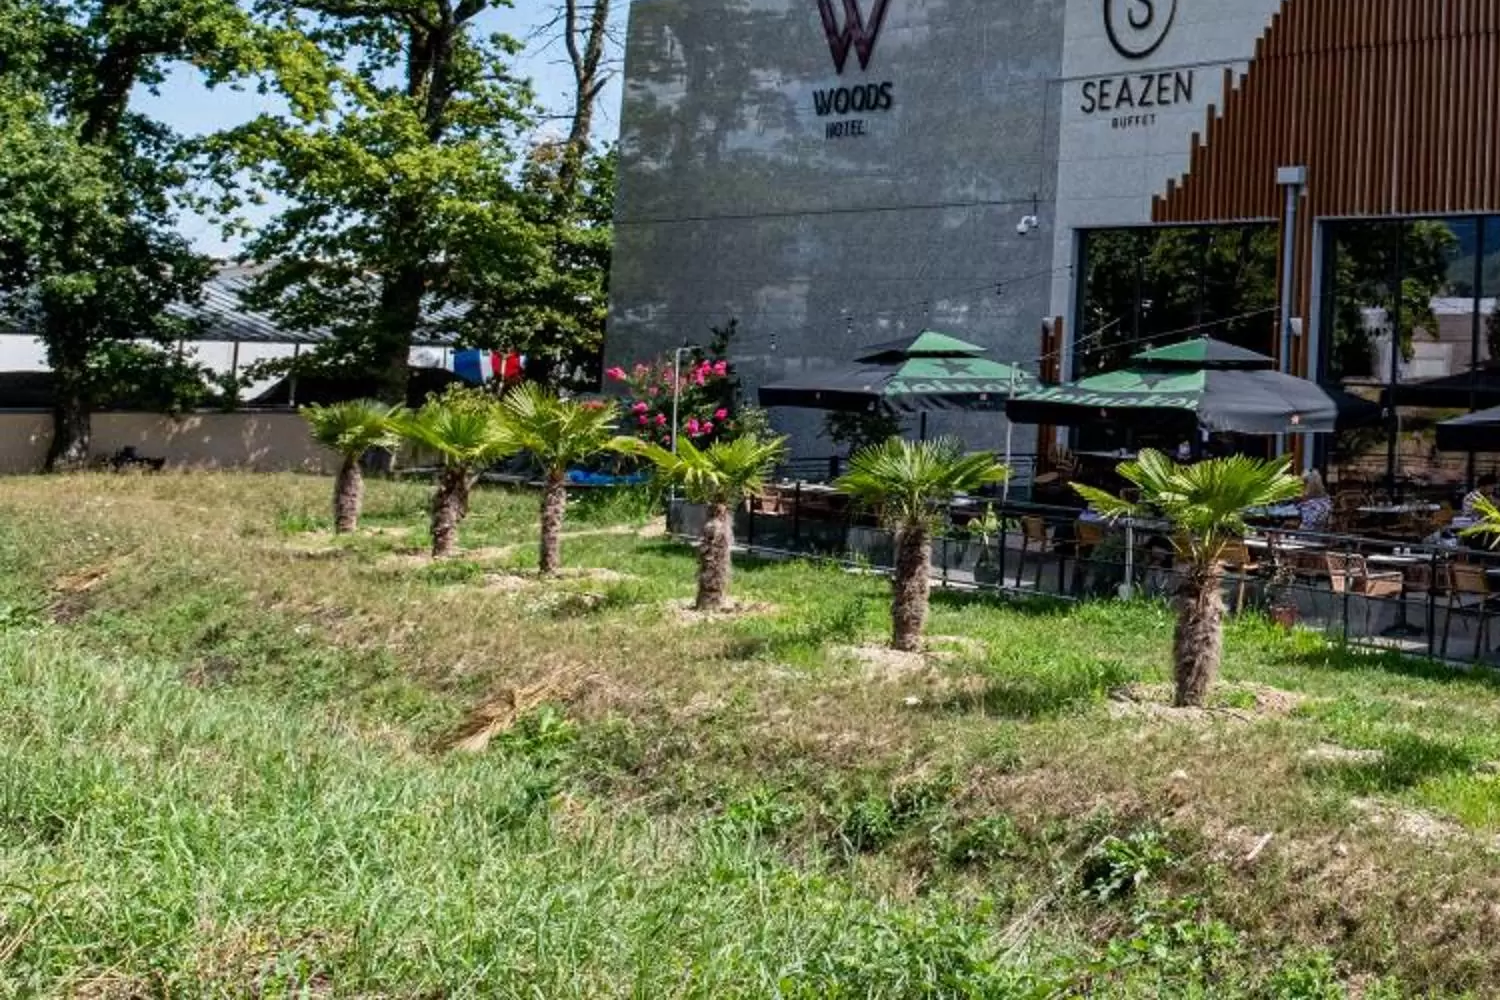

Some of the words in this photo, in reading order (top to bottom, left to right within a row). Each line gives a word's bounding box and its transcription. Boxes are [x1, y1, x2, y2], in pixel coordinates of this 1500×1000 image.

[812, 81, 893, 116] WOODS
[1080, 70, 1193, 114] SEAZEN
[825, 119, 865, 139] HOTEL
[1111, 113, 1155, 128] BUFFET
